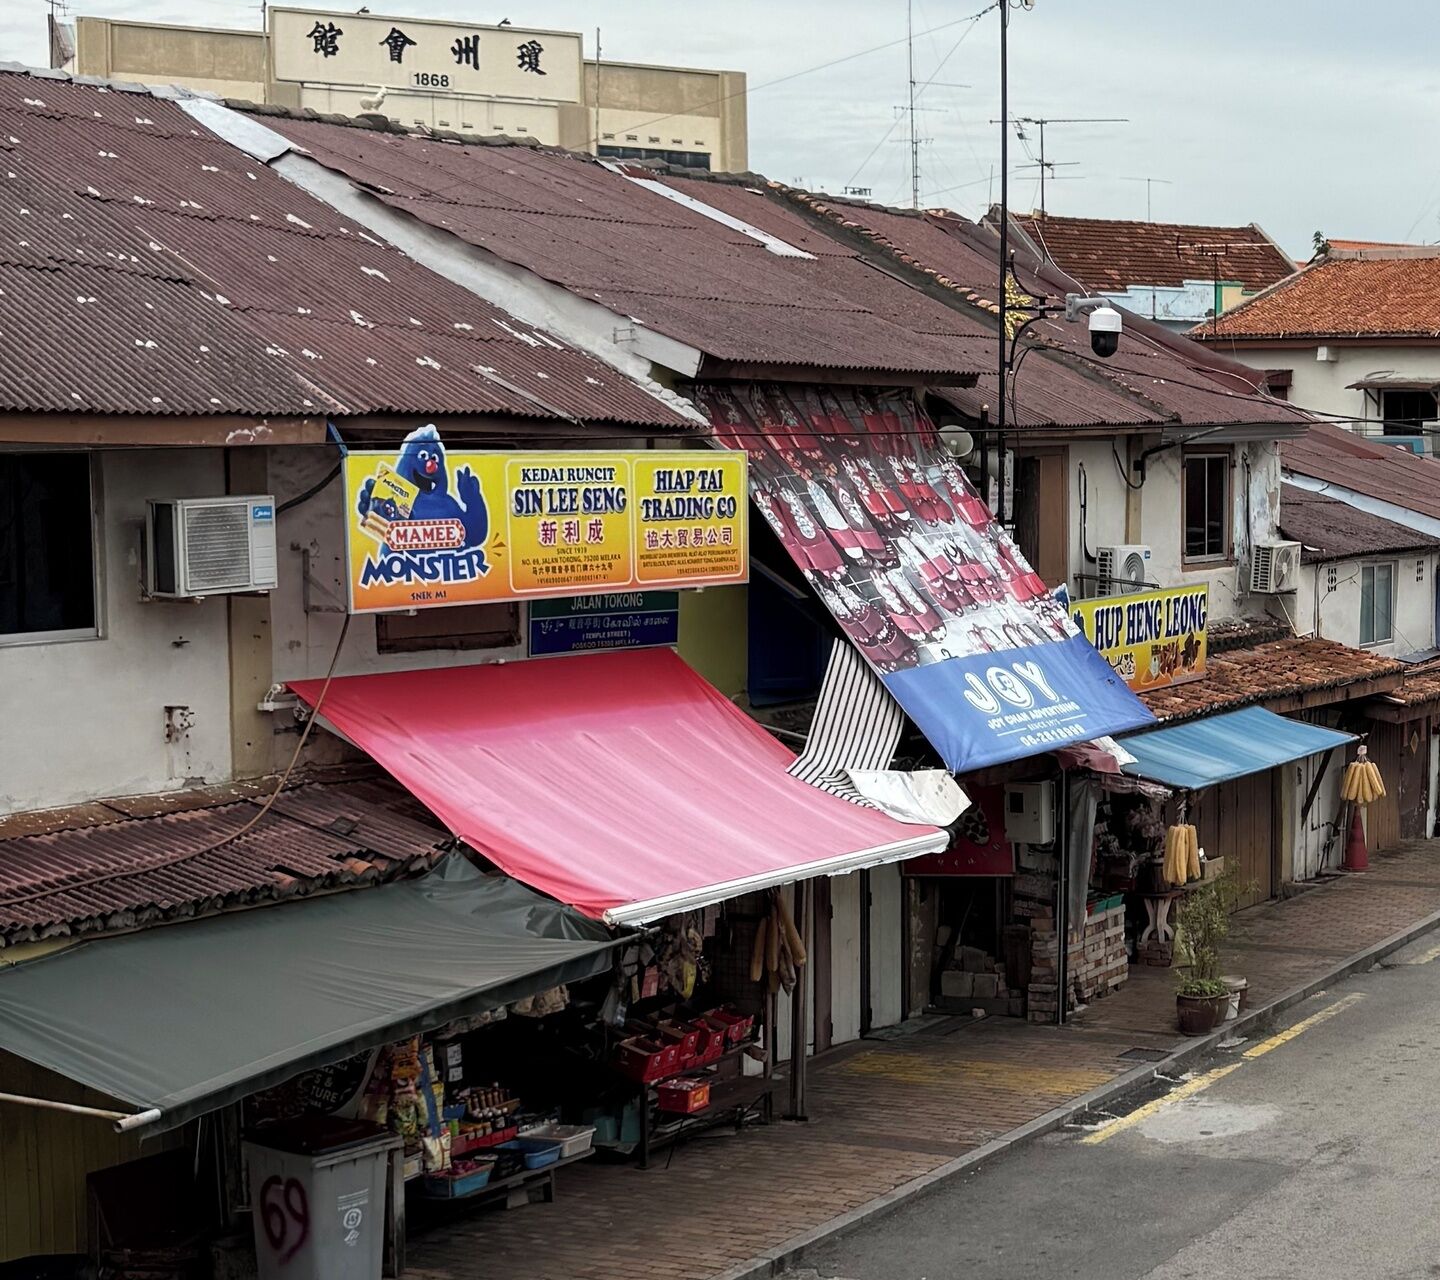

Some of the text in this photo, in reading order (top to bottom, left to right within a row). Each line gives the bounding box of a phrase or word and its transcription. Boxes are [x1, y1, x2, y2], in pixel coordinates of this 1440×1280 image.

[413, 72, 450, 88] 1868
[521, 468, 615, 483] KEDAI RUNCIT
[656, 470, 723, 491] HIAP TAI
[514, 487, 627, 515] SIN LEE SENG
[642, 496, 737, 520] TRADING CO
[396, 526, 456, 544] MAMEE
[541, 519, 604, 544] 新利成
[361, 549, 492, 588] MONSTER
[410, 591, 447, 601] SNEK MI
[571, 593, 643, 610] JALAN TOKONG
[1094, 593, 1207, 650] HUP HENG LEONG
[963, 661, 1060, 716] JOY
[988, 701, 1081, 730] JOY CHAN ADVERTISING
